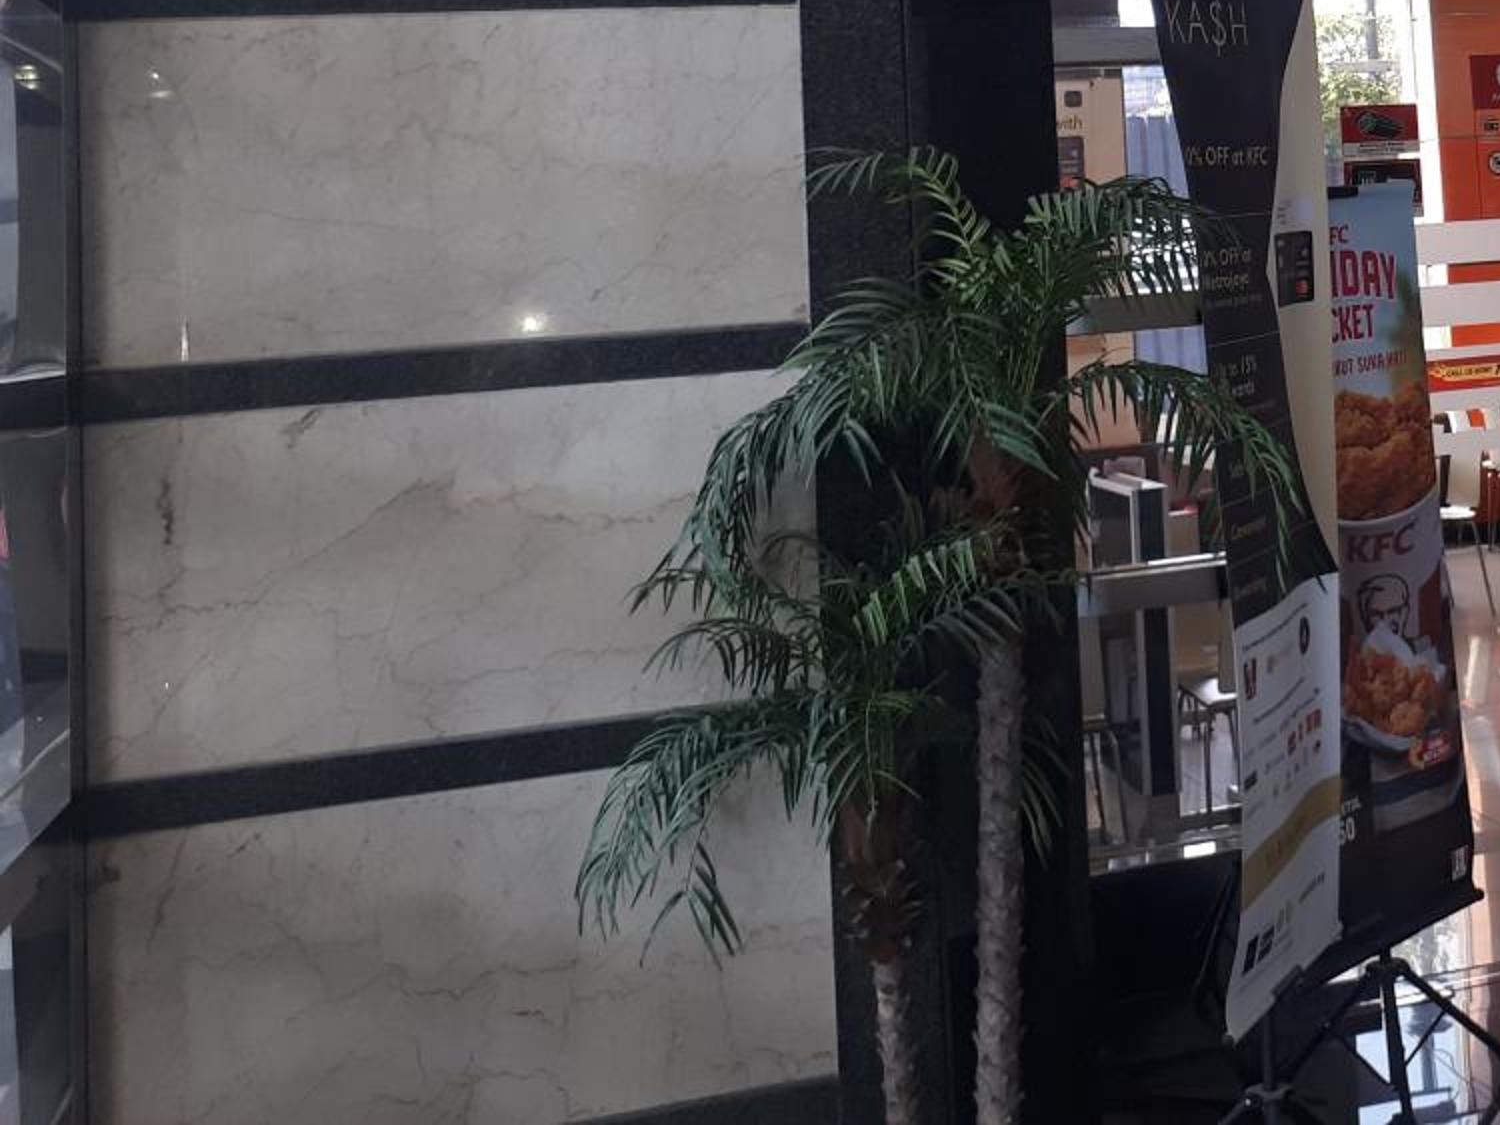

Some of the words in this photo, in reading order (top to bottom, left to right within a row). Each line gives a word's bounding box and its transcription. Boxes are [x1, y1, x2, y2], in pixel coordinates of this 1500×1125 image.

[1205, 145, 1230, 166] OFF
[1329, 225, 1349, 245] FC
[1330, 250, 1398, 300] IDAY
[1345, 521, 1416, 563] KFC
